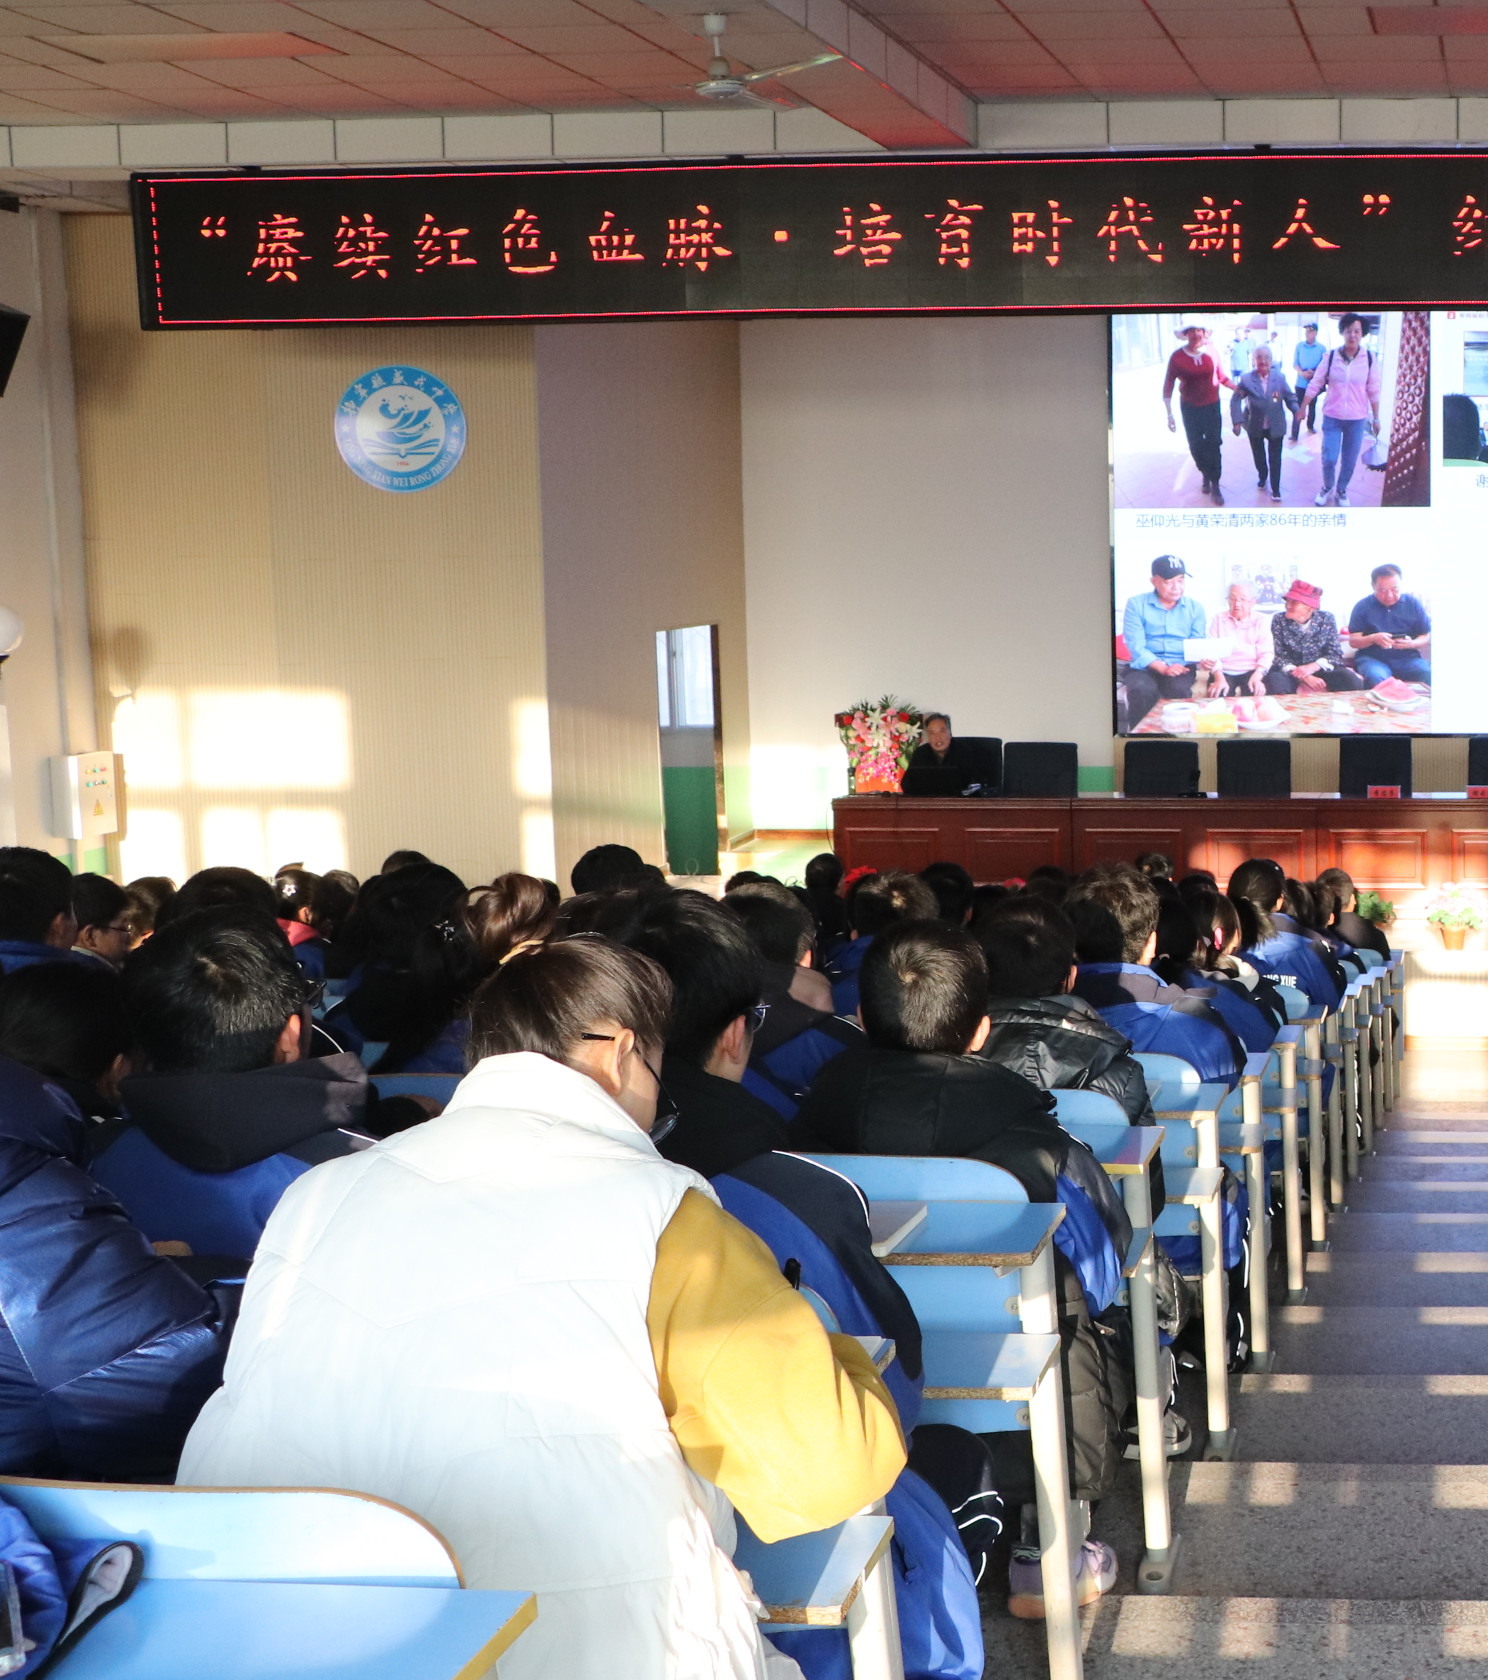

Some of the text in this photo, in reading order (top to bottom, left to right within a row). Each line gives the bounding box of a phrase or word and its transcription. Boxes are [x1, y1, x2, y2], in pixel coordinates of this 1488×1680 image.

[1135, 512, 1348, 528] 巫仰光与黄荣清两家86年的亲情
[1280, 975, 1298, 989] XUE
